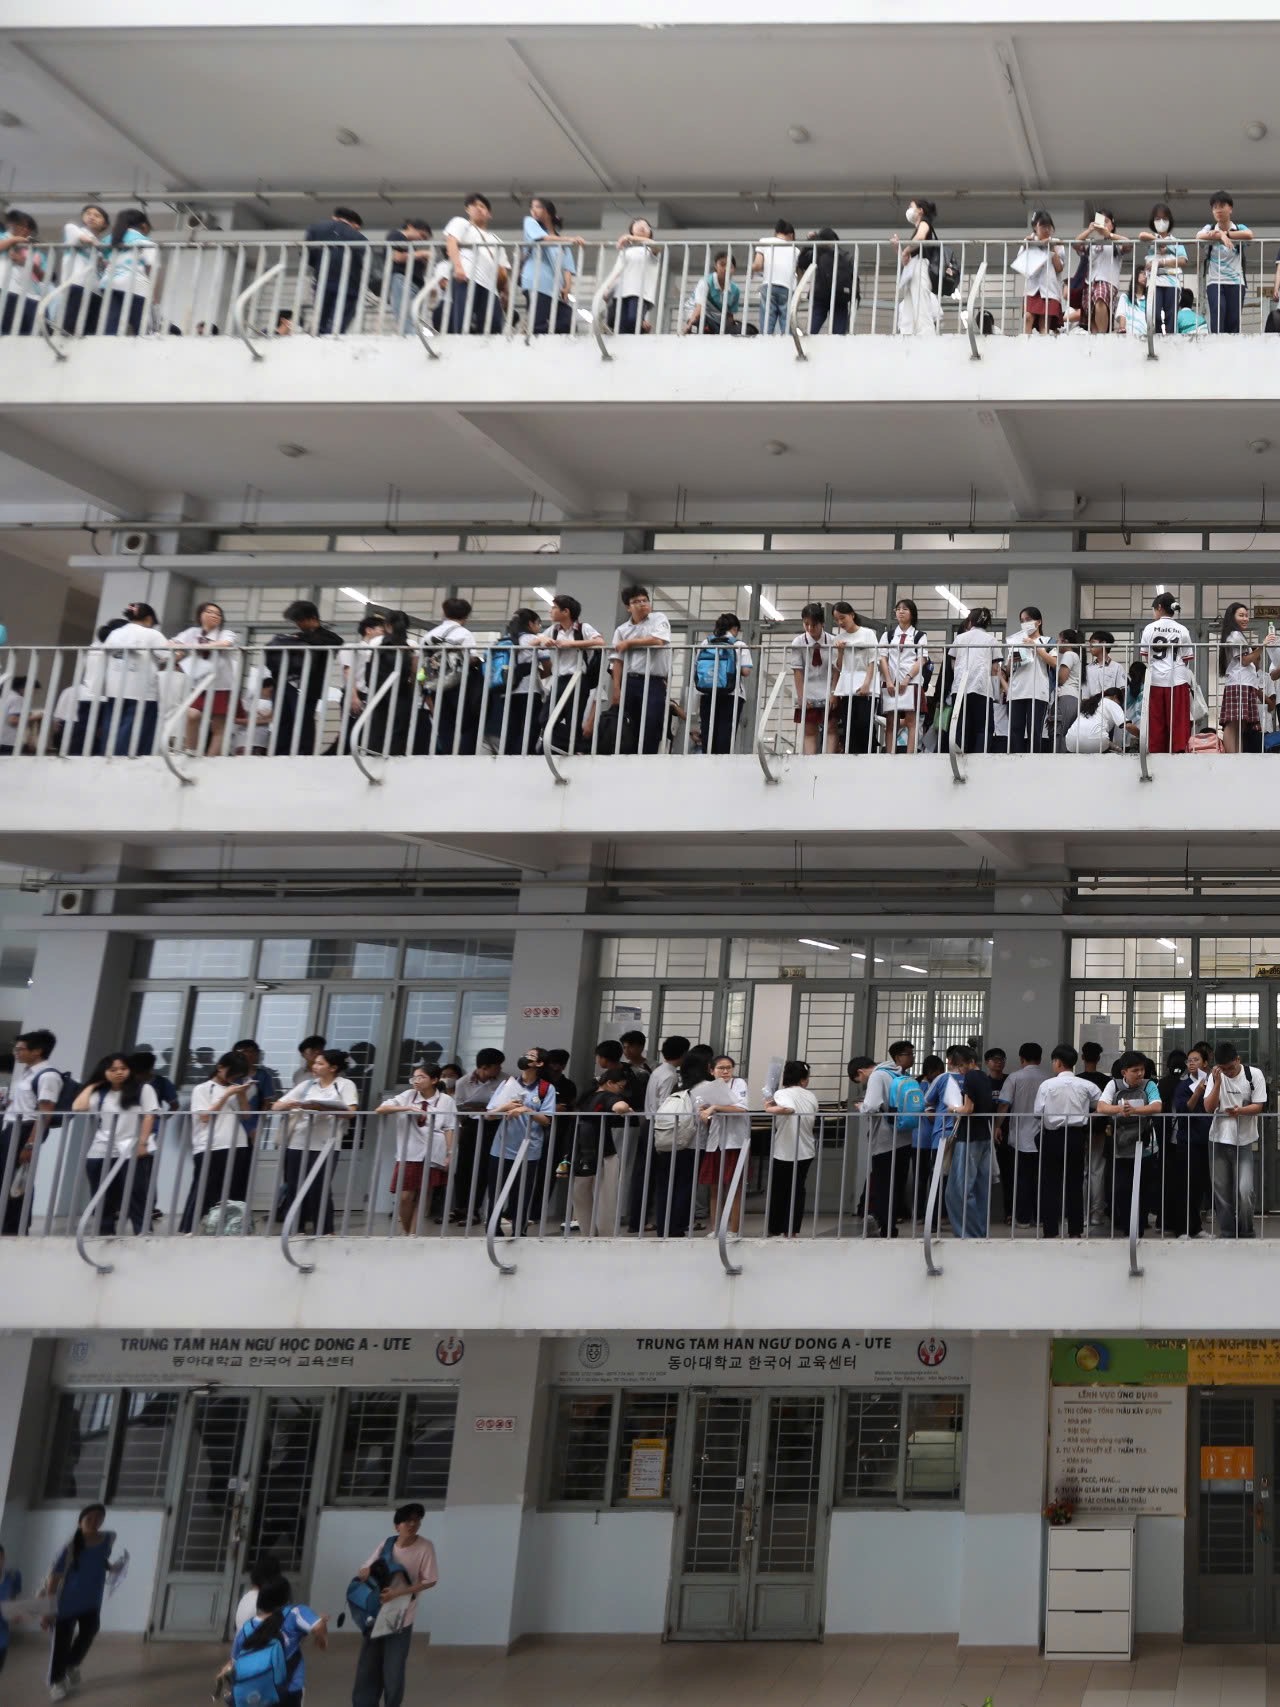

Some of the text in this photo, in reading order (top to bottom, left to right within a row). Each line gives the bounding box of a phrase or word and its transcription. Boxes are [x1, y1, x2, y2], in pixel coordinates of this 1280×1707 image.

[1153, 636, 1180, 661] 91
[120, 1338, 168, 1351] TRUNG
[280, 1338, 310, 1354] HỌC
[383, 1338, 412, 1351] UTE
[636, 1338, 685, 1350] TRUNG
[864, 1338, 892, 1350] UTE
[172, 1355, 355, 1368] 동아대학교 한국어 교육센터
[667, 1355, 857, 1370] 동아대학교 한국어 교육센터
